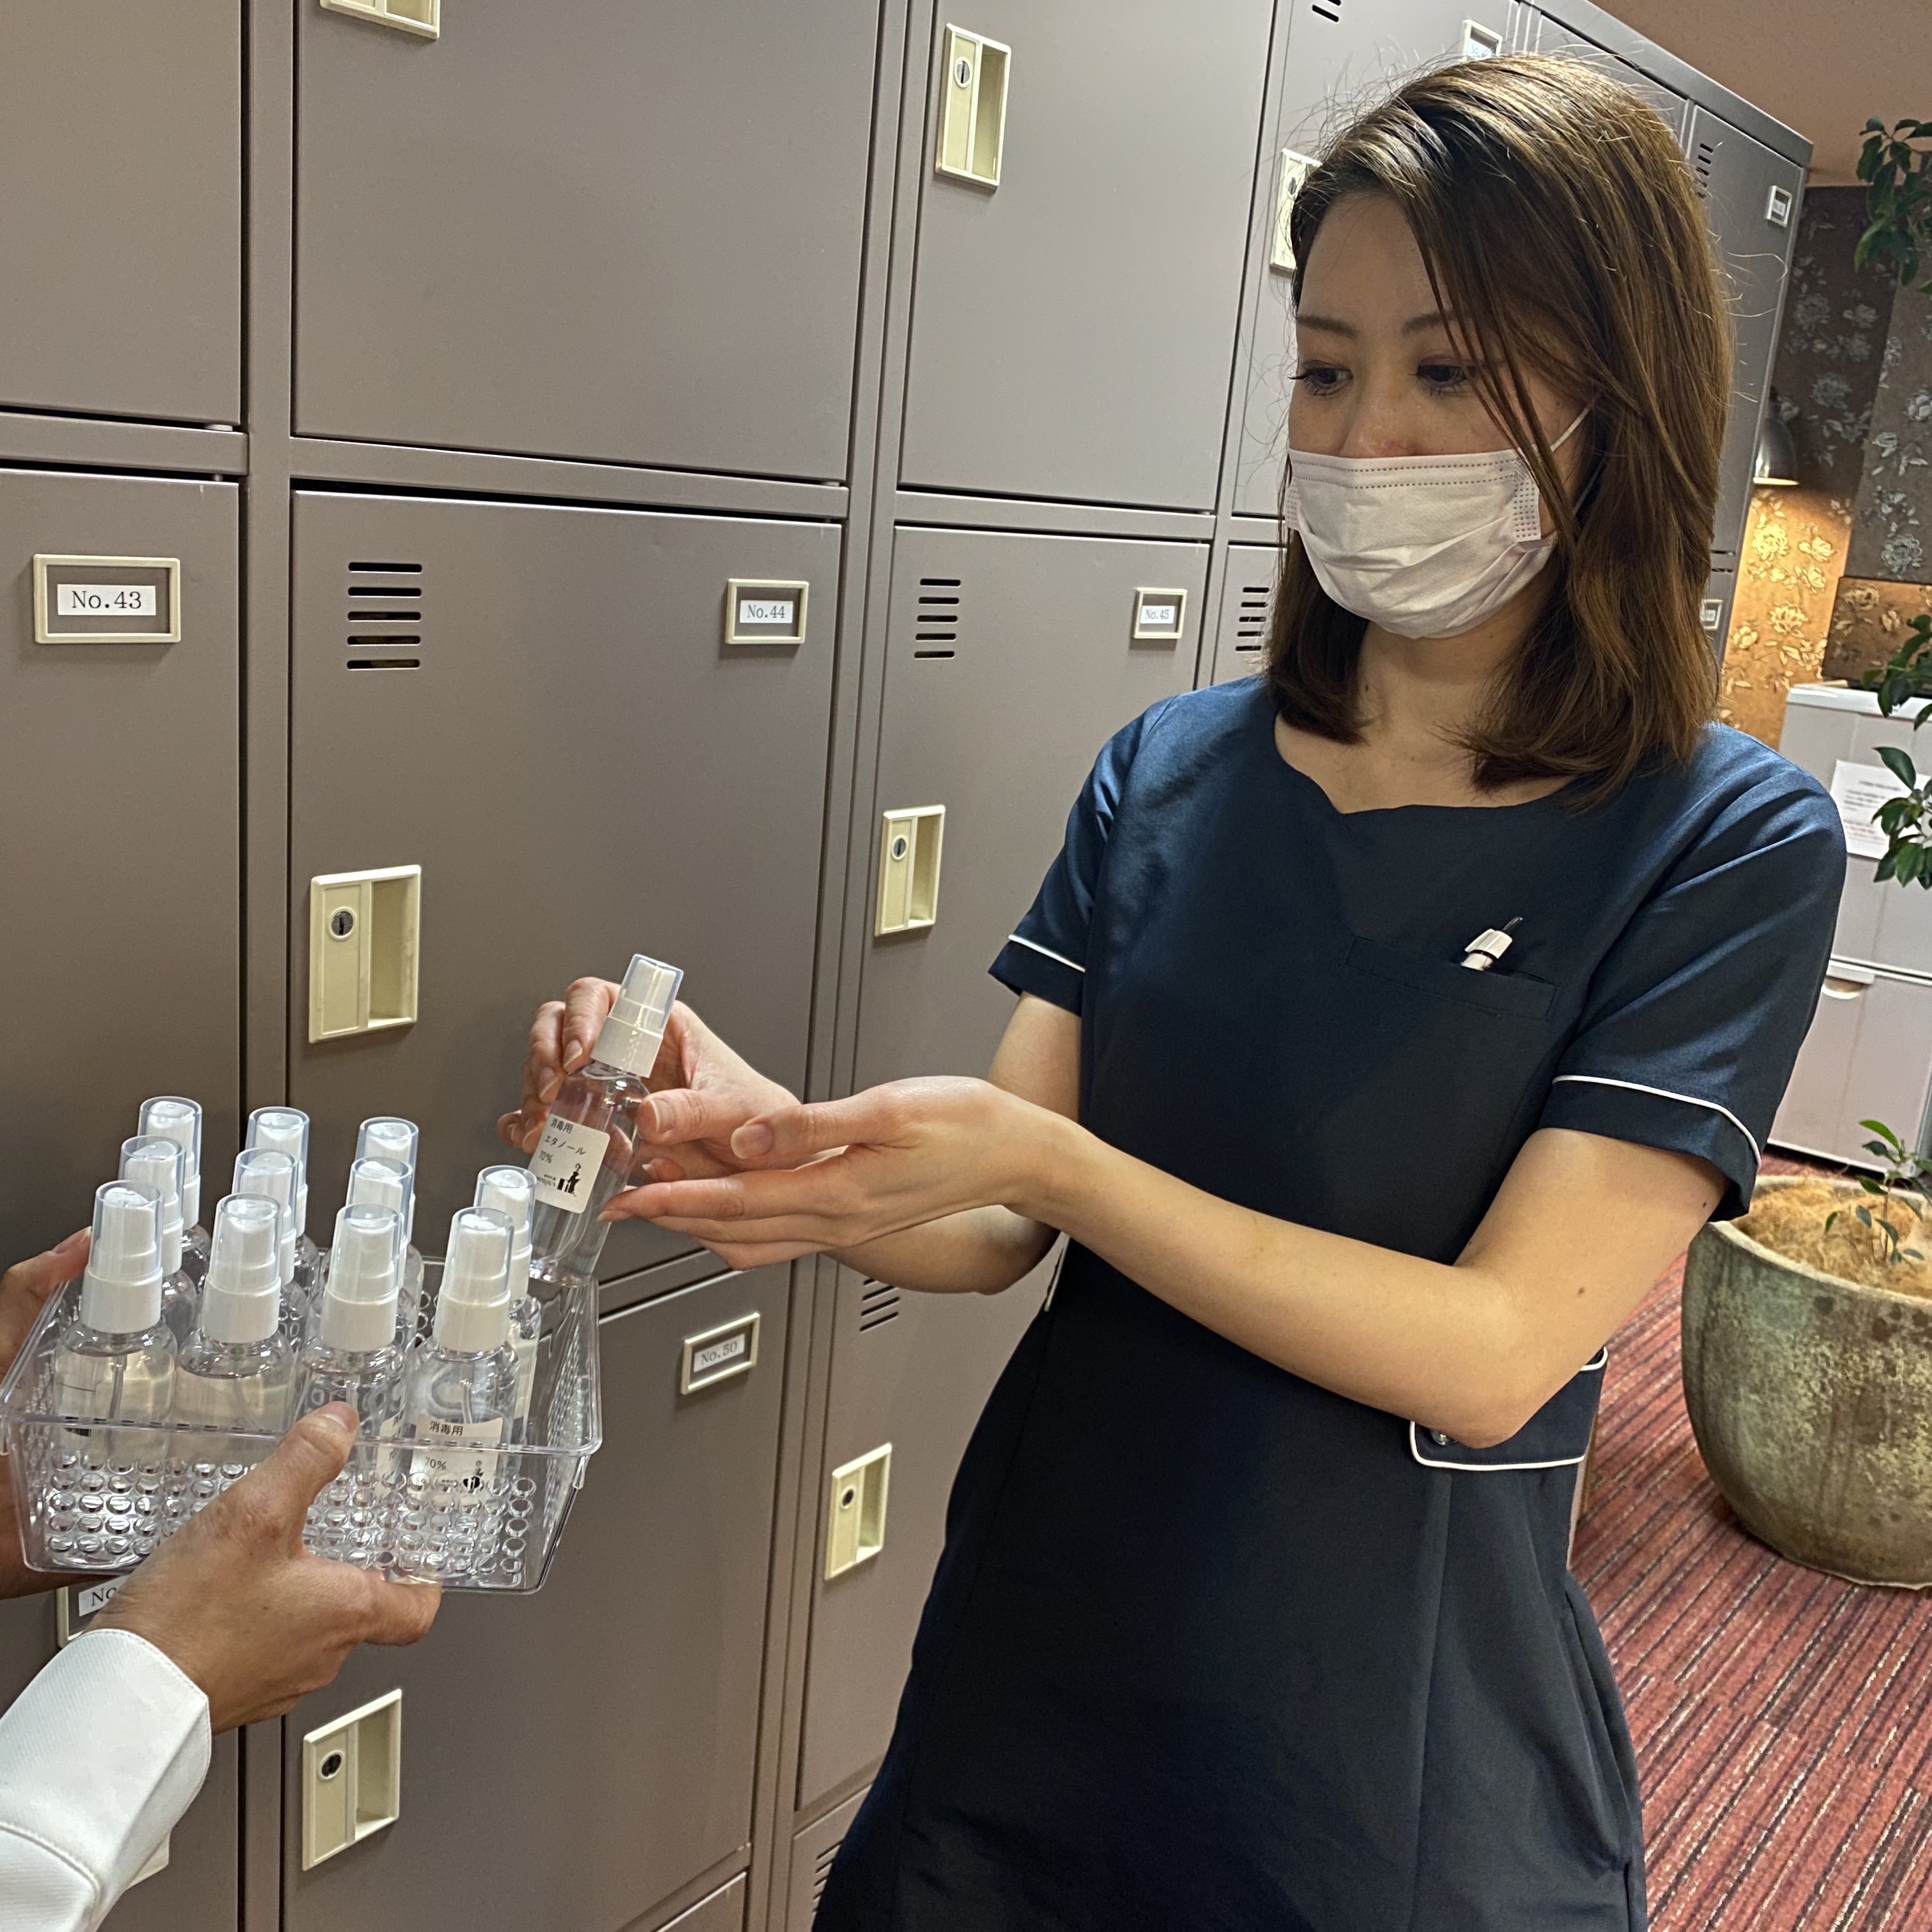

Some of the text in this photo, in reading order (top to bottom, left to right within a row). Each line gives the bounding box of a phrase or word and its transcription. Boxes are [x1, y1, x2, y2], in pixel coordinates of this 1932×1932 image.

[72, 590, 142, 609] No.43
[747, 604, 785, 618] No.44
[1145, 609, 1170, 620] No.45
[549, 1117, 574, 1134] 消毒用
[544, 1135, 586, 1155] エタノール
[700, 1340, 738, 1366] No.50
[429, 1420, 463, 1436] 消毒用
